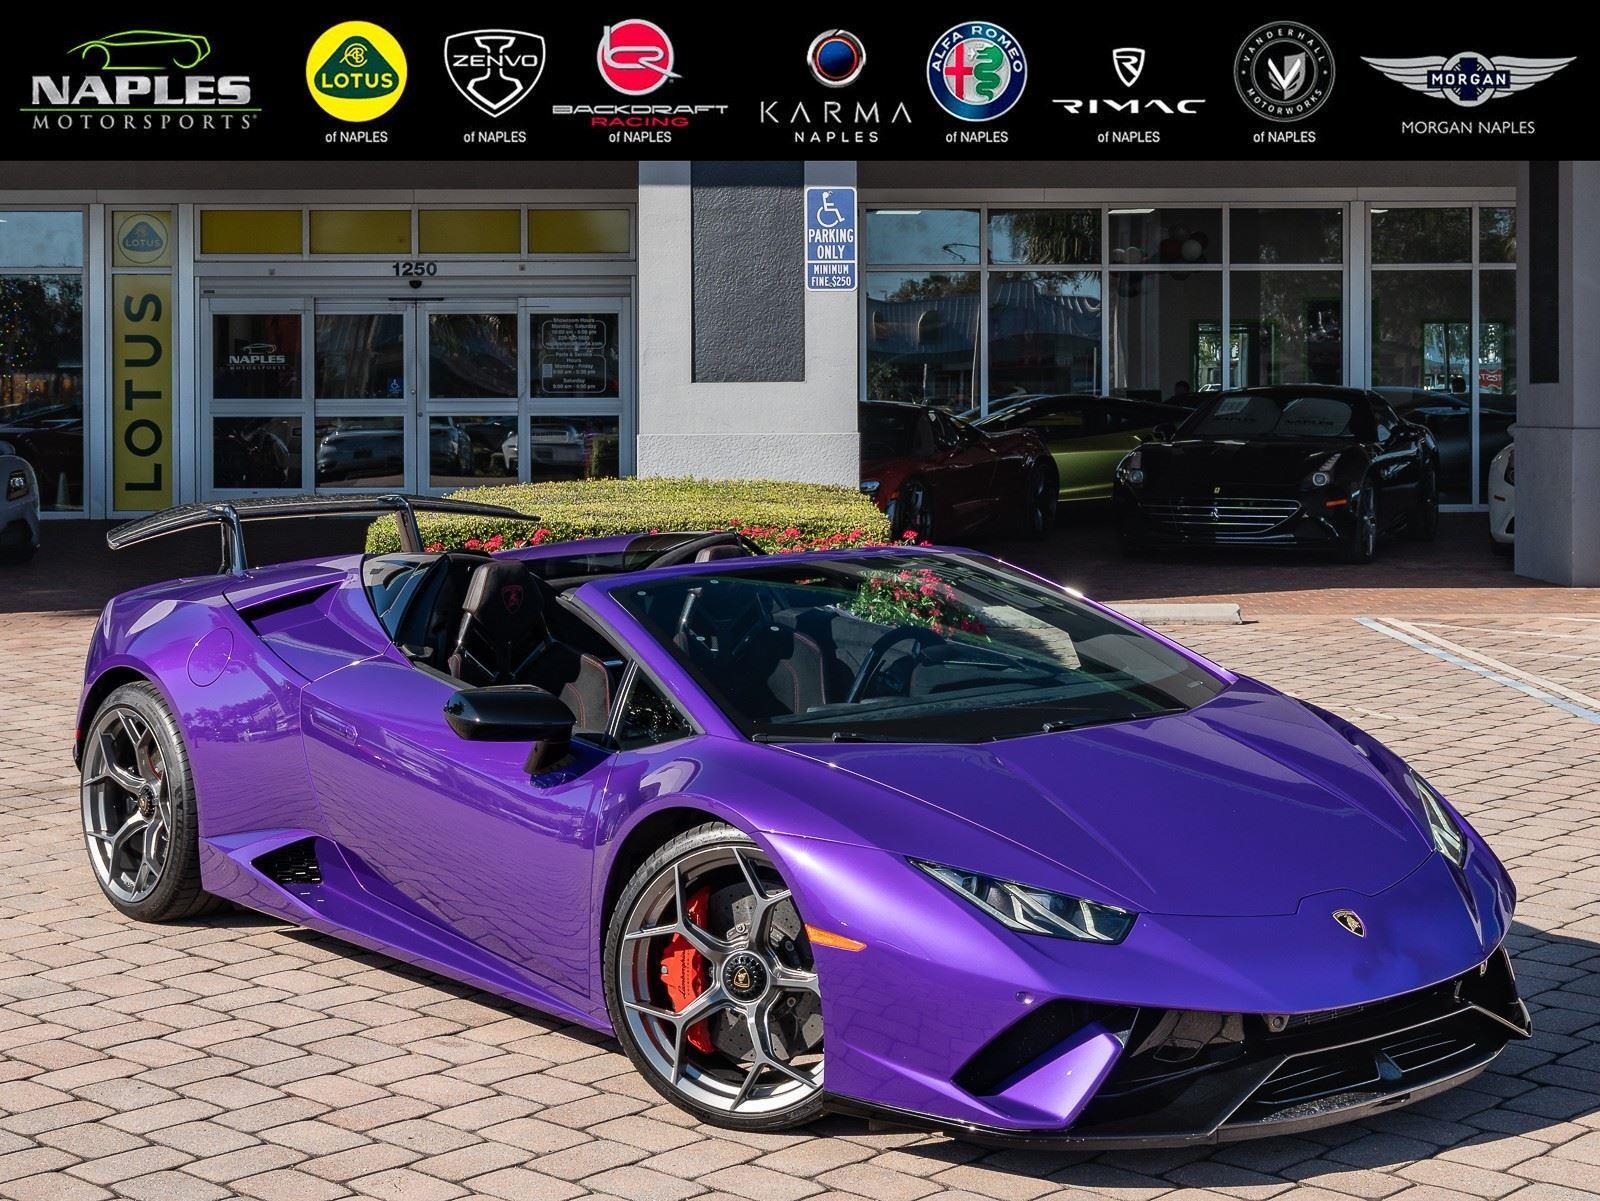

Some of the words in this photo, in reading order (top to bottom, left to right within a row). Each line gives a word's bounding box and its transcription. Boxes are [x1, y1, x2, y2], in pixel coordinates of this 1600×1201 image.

[808, 228, 854, 243] PARKING
[126, 239, 160, 248] LOTUS
[817, 245, 845, 260] ONLY
[392, 261, 437, 277] 1250
[813, 264, 849, 275] MINIMUM
[811, 276, 829, 287] FINE
[831, 276, 851, 287] $250
[229, 355, 286, 364] NAPLES
[124, 293, 163, 491] LOTUS
